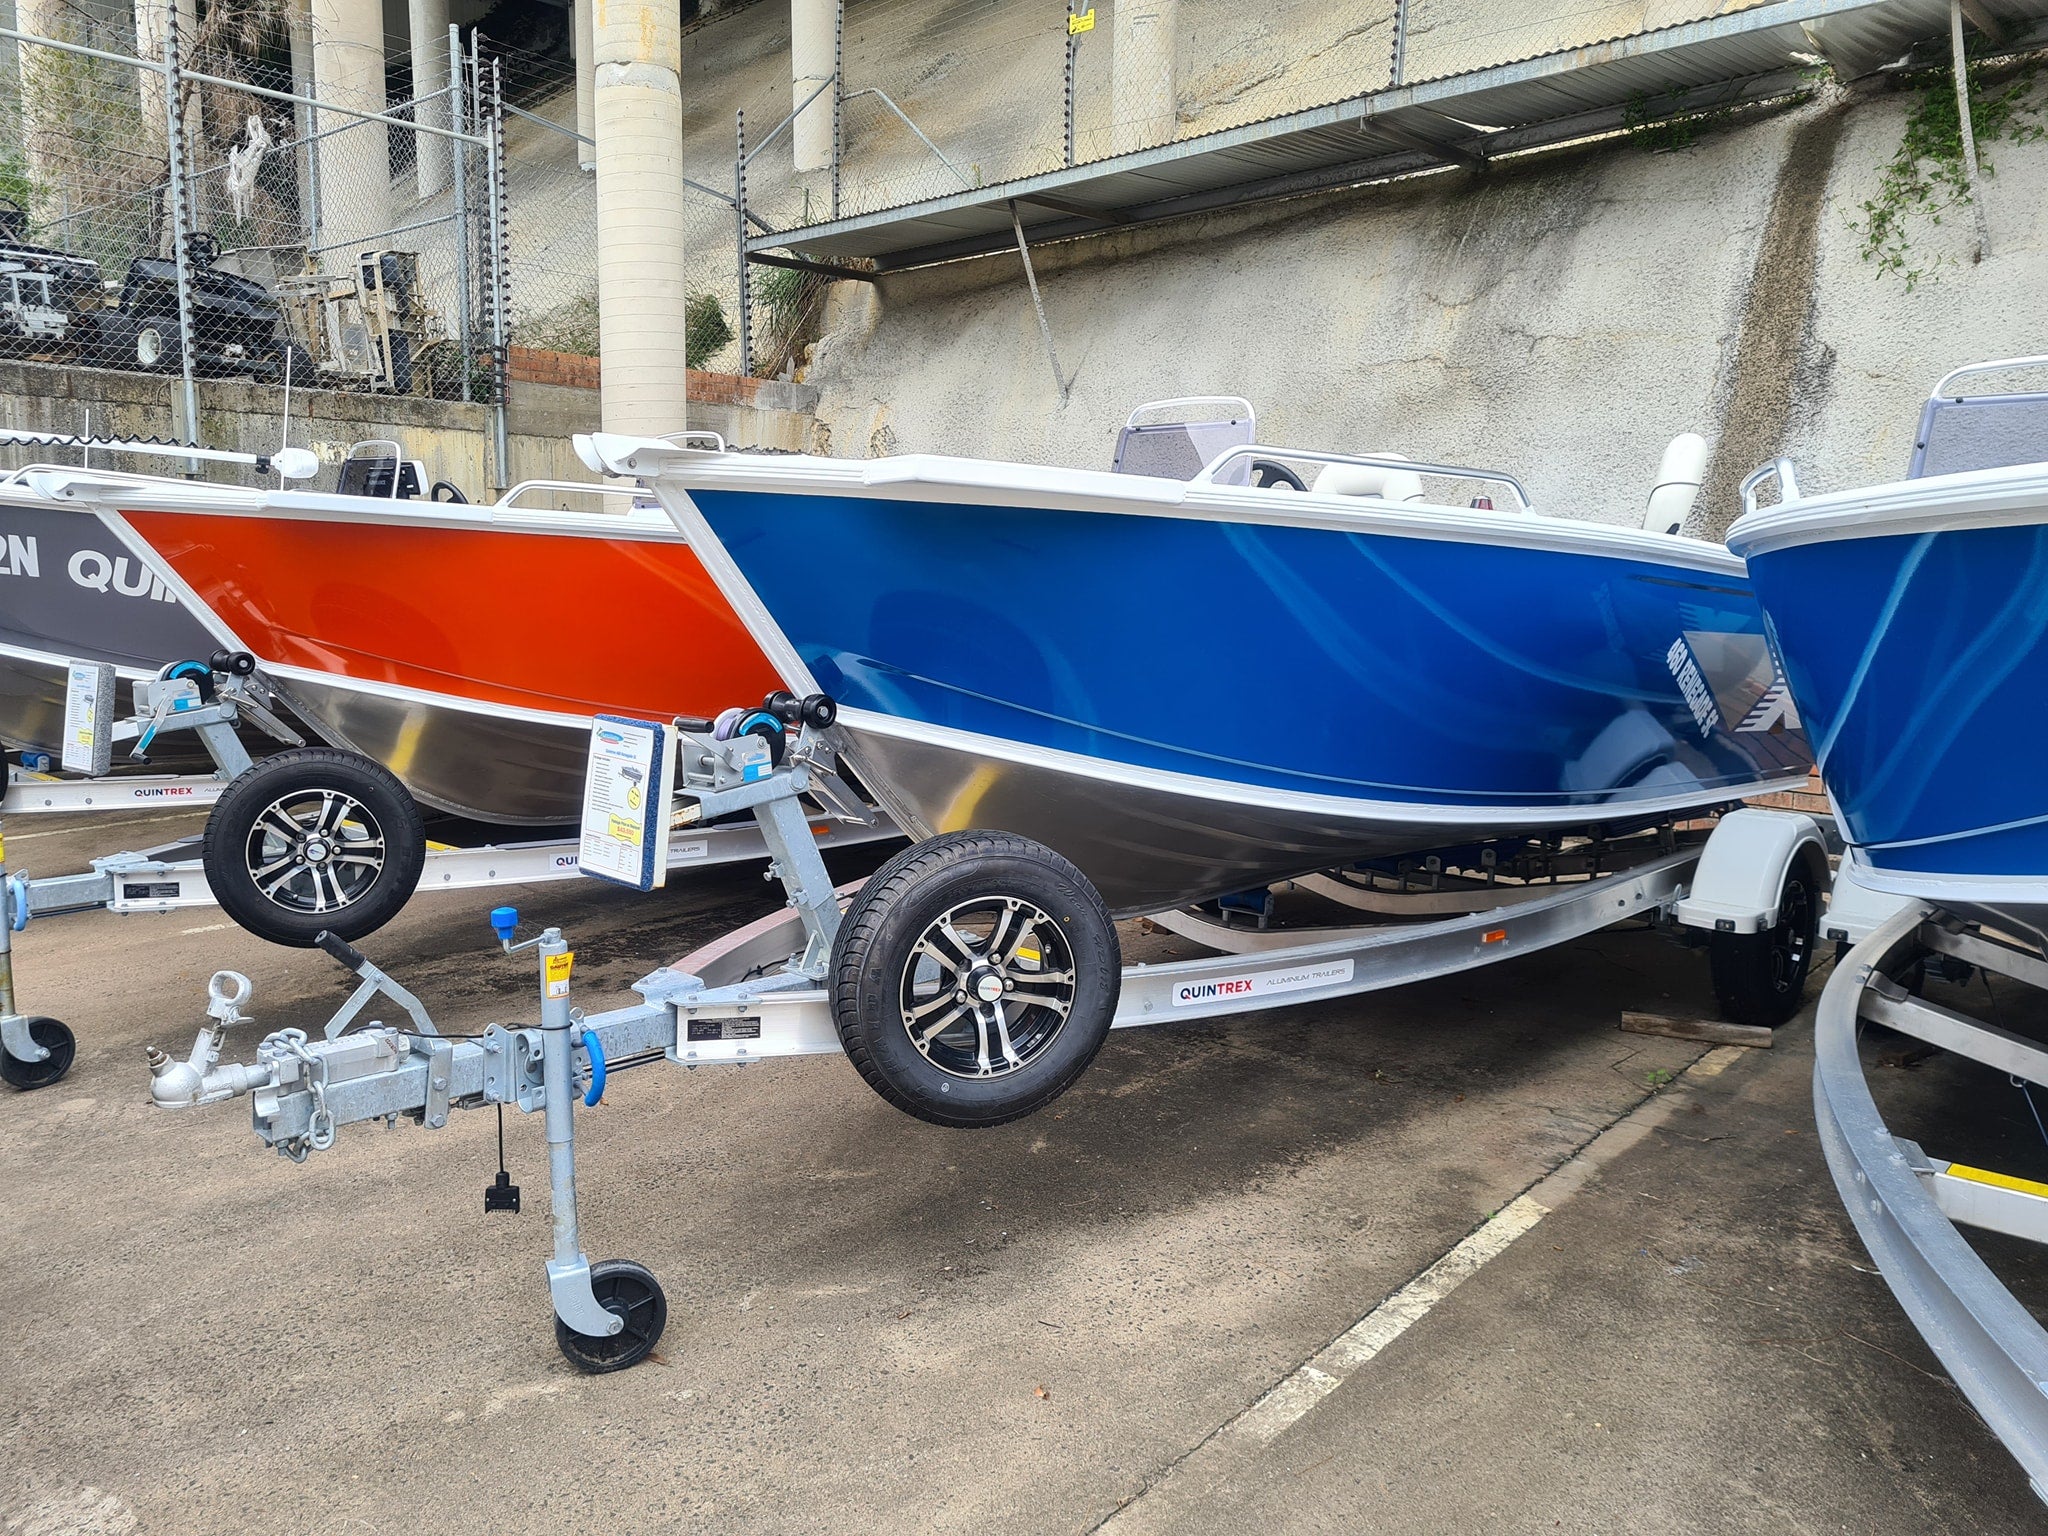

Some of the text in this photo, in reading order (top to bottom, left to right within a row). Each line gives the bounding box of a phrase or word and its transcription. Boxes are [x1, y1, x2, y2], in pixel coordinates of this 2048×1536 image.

[67, 550, 177, 604] QUI
[1666, 637, 1719, 738] 460 RENEGADE SC
[134, 787, 193, 797] QUINTREX
[1180, 968, 1346, 1000] QUINTREX ALUMINIUM TRAILERS
